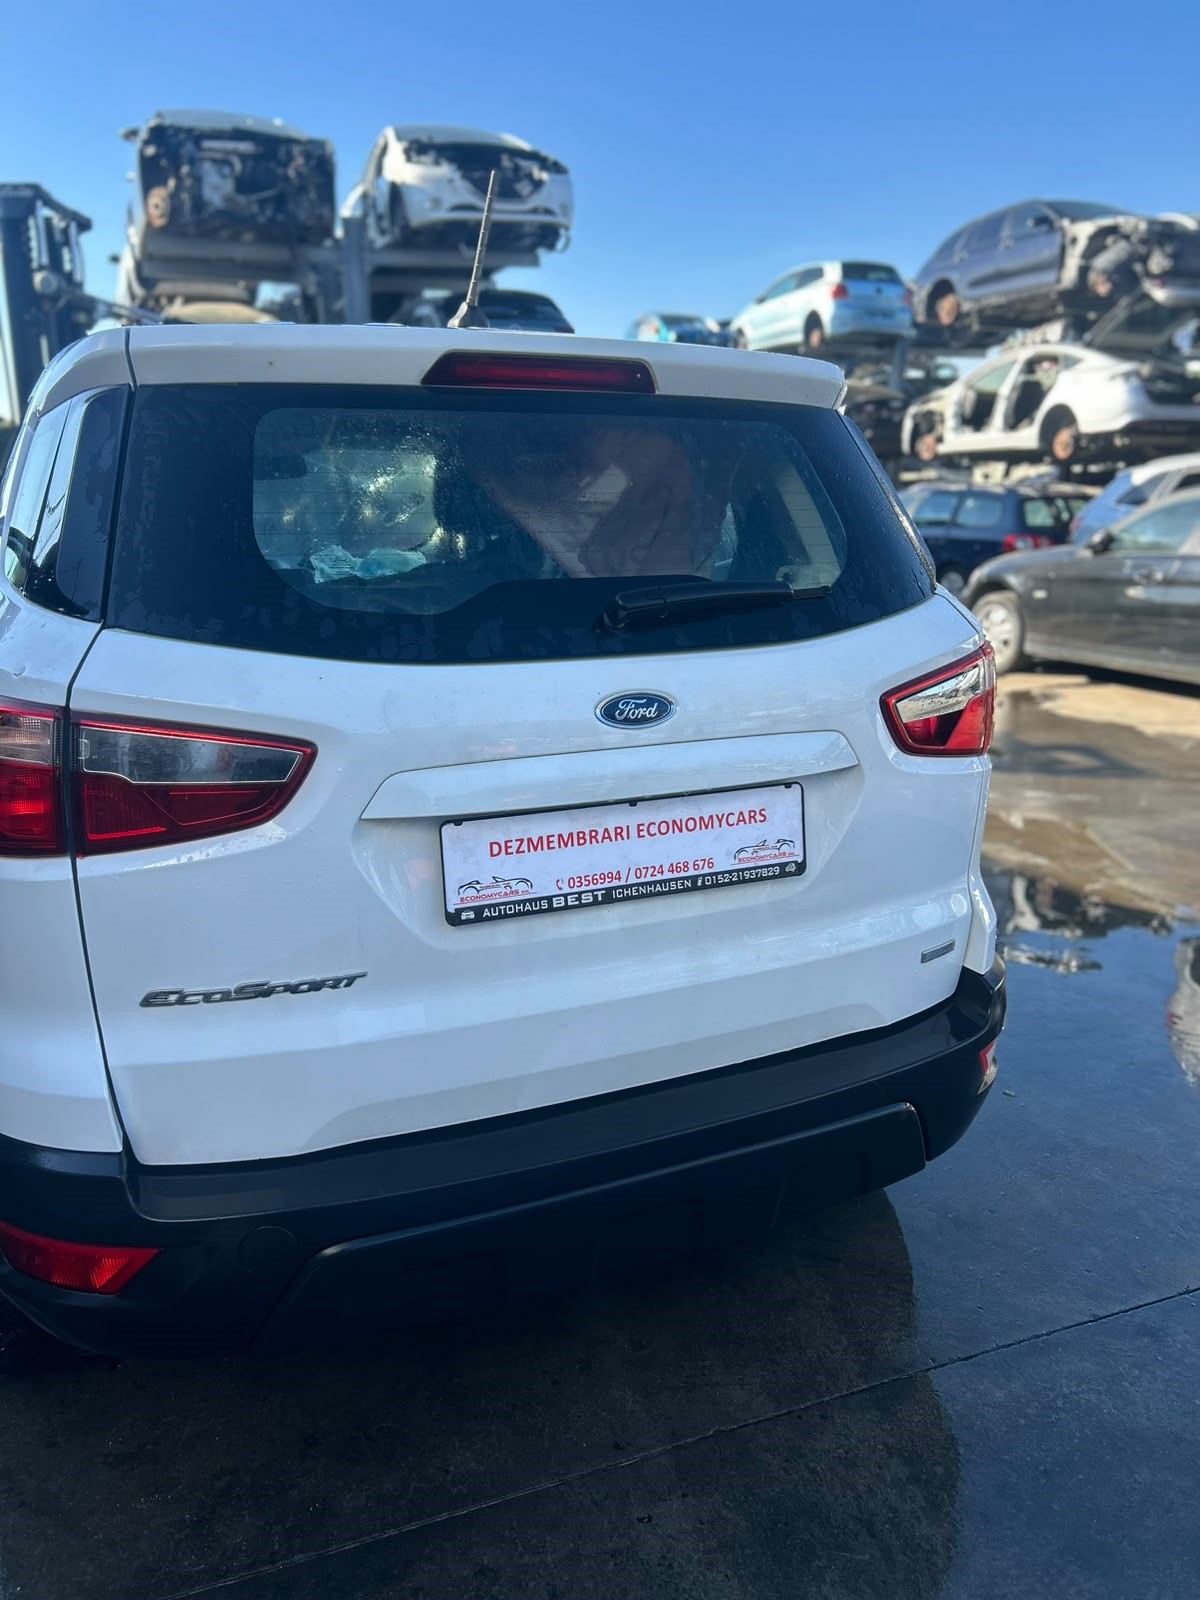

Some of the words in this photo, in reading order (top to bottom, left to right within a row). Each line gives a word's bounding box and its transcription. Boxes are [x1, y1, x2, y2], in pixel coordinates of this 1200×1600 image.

[615, 699, 658, 720] Ford
[489, 824, 631, 858] DEZMEMBRARI
[636, 808, 767, 839] ECONOMYCARS
[738, 851, 788, 864] ECONOMYCARS
[567, 870, 622, 889] 0356994
[625, 867, 631, 883] /
[635, 864, 664, 880] 0724
[668, 860, 690, 874] 468
[693, 857, 715, 871] 676
[460, 889, 520, 903] ECONOMYCARS
[482, 899, 548, 918] AUTOHAUS
[552, 891, 606, 908] BEST
[612, 879, 692, 899] ICHENHAUSEN
